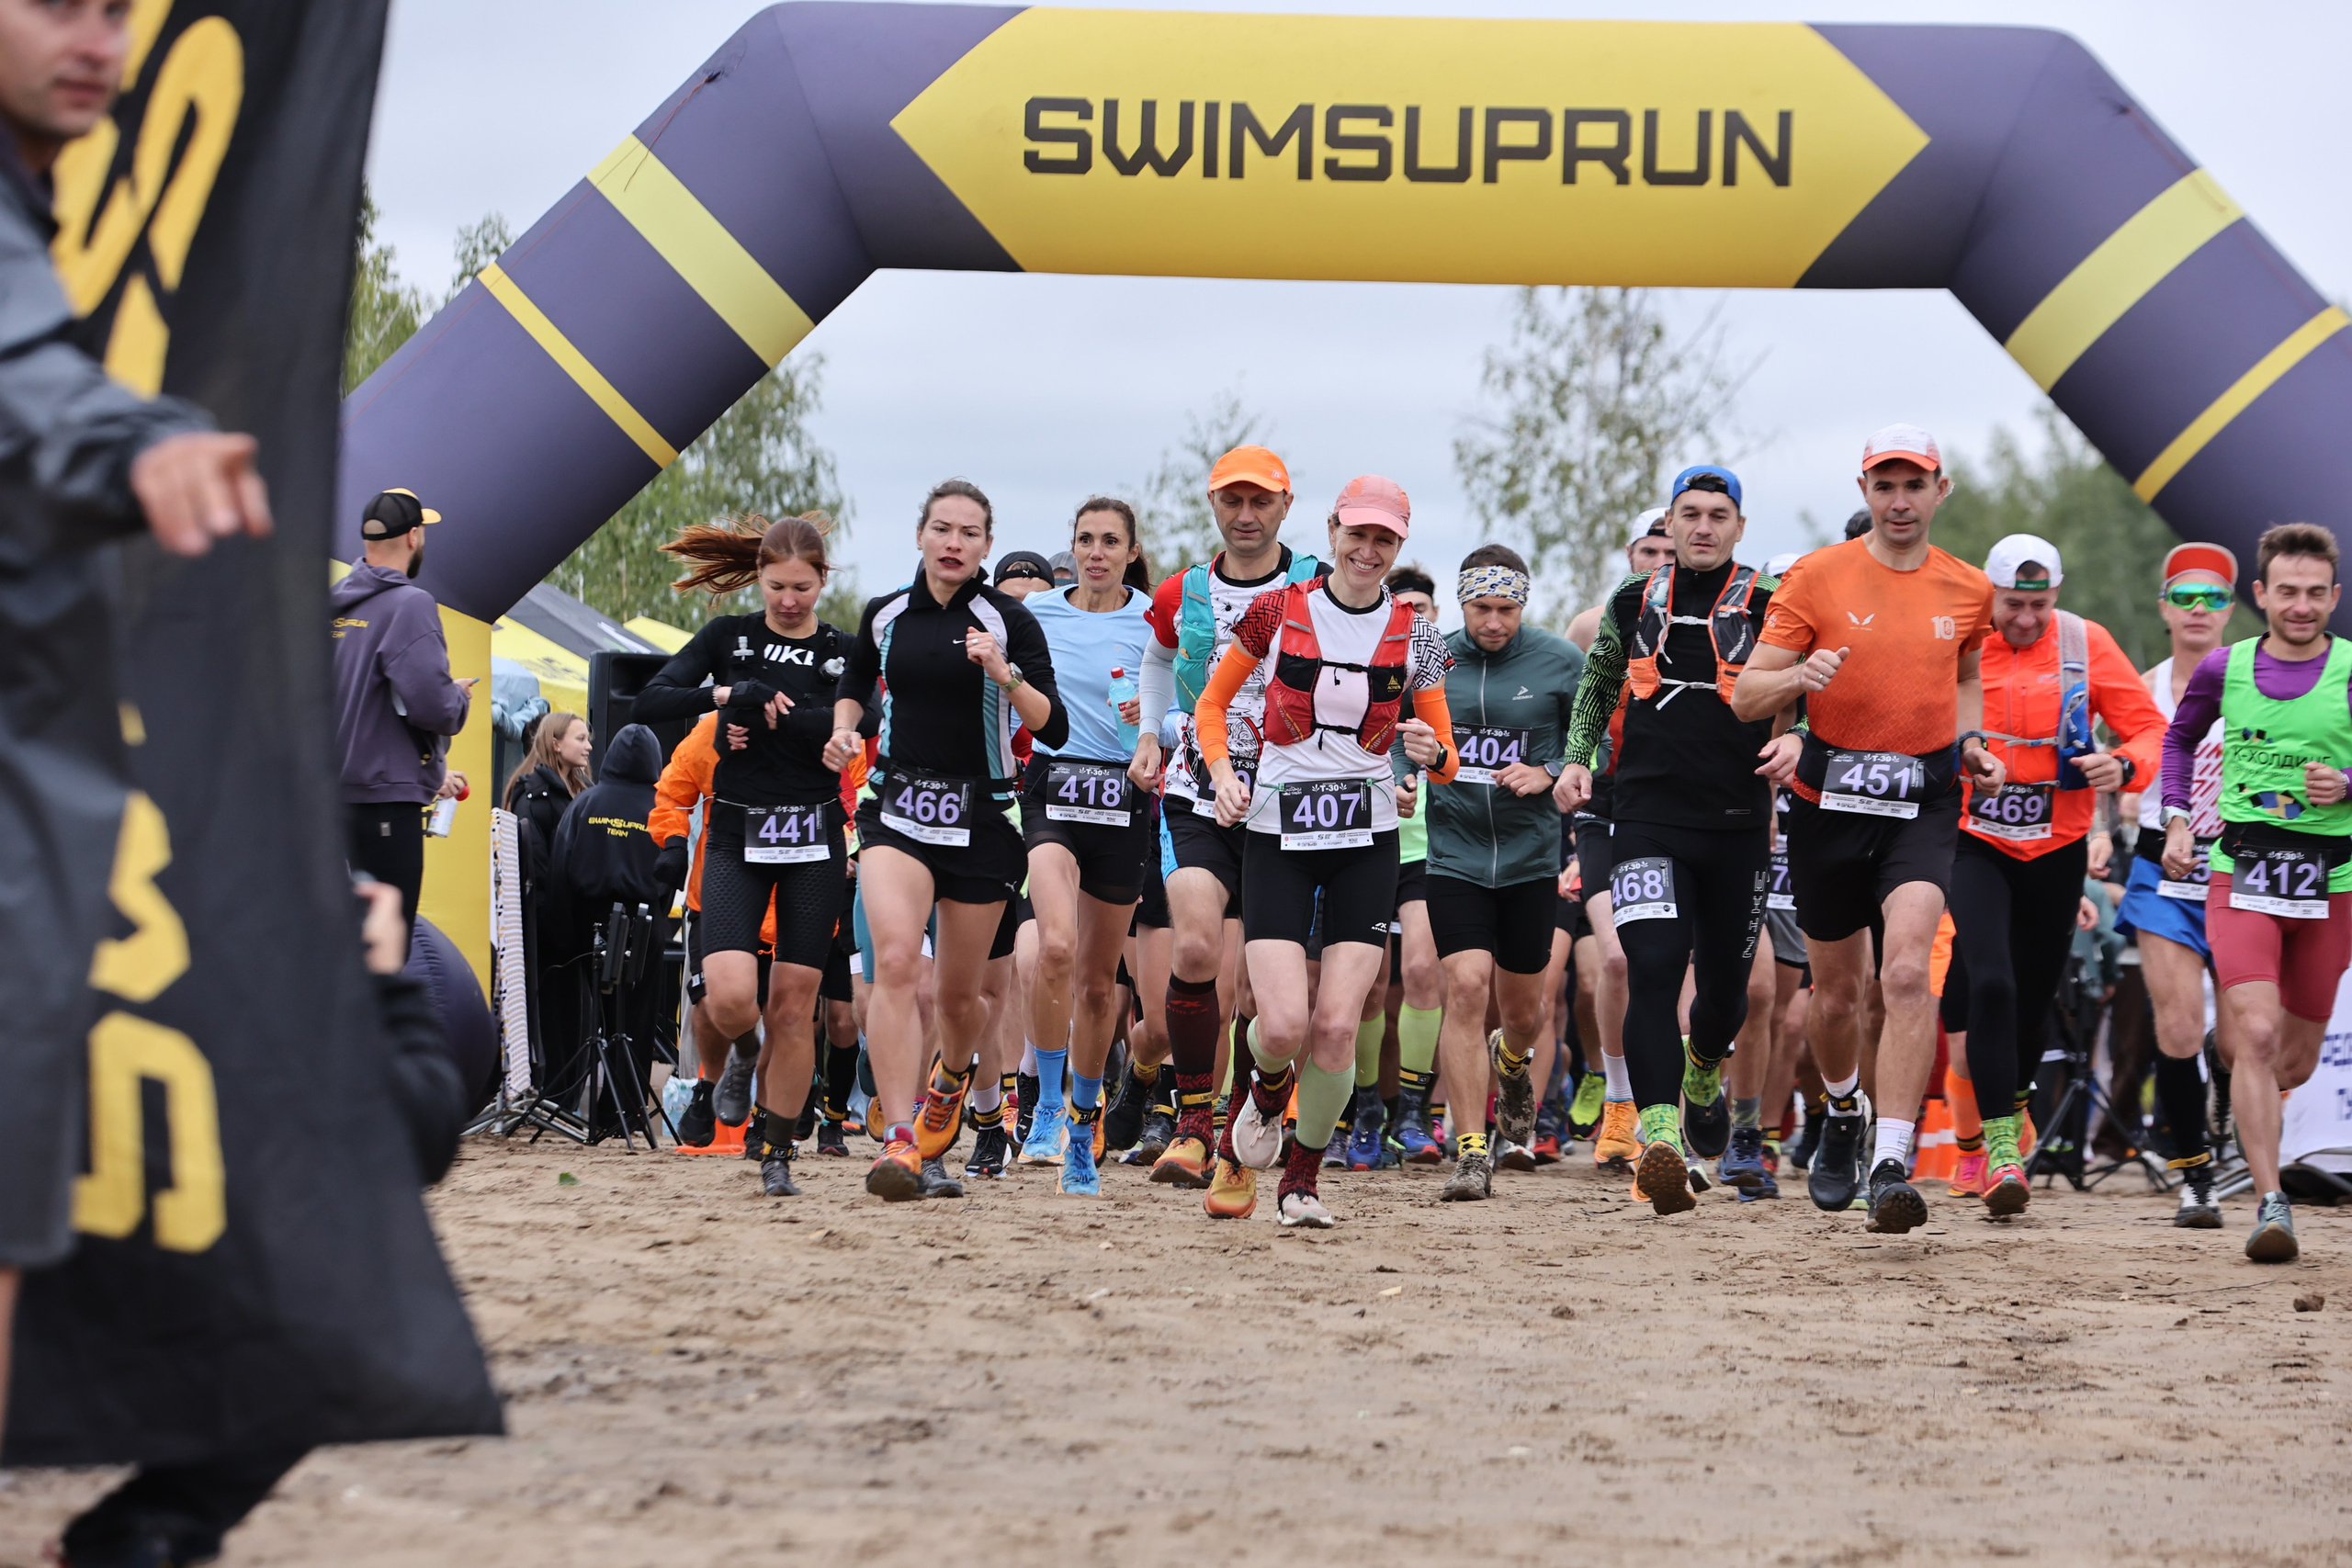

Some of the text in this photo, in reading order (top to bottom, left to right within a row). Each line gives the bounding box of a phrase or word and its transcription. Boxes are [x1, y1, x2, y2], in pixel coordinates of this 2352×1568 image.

[1023, 96, 1793, 187] SWIMSUPRUN
[1459, 735, 1521, 766] 404
[1057, 774, 1121, 807] 418
[1319, 784, 1340, 792] T-30
[1839, 762, 1911, 799] 451
[895, 785, 961, 825] 466
[1293, 792, 1361, 829] 407
[1978, 795, 2044, 823] 469
[588, 817, 649, 832] SWIMSUPRU
[607, 828, 628, 838] TEAM
[758, 813, 816, 844] 441
[1611, 869, 1664, 908] 468
[2244, 860, 2318, 897] 412
